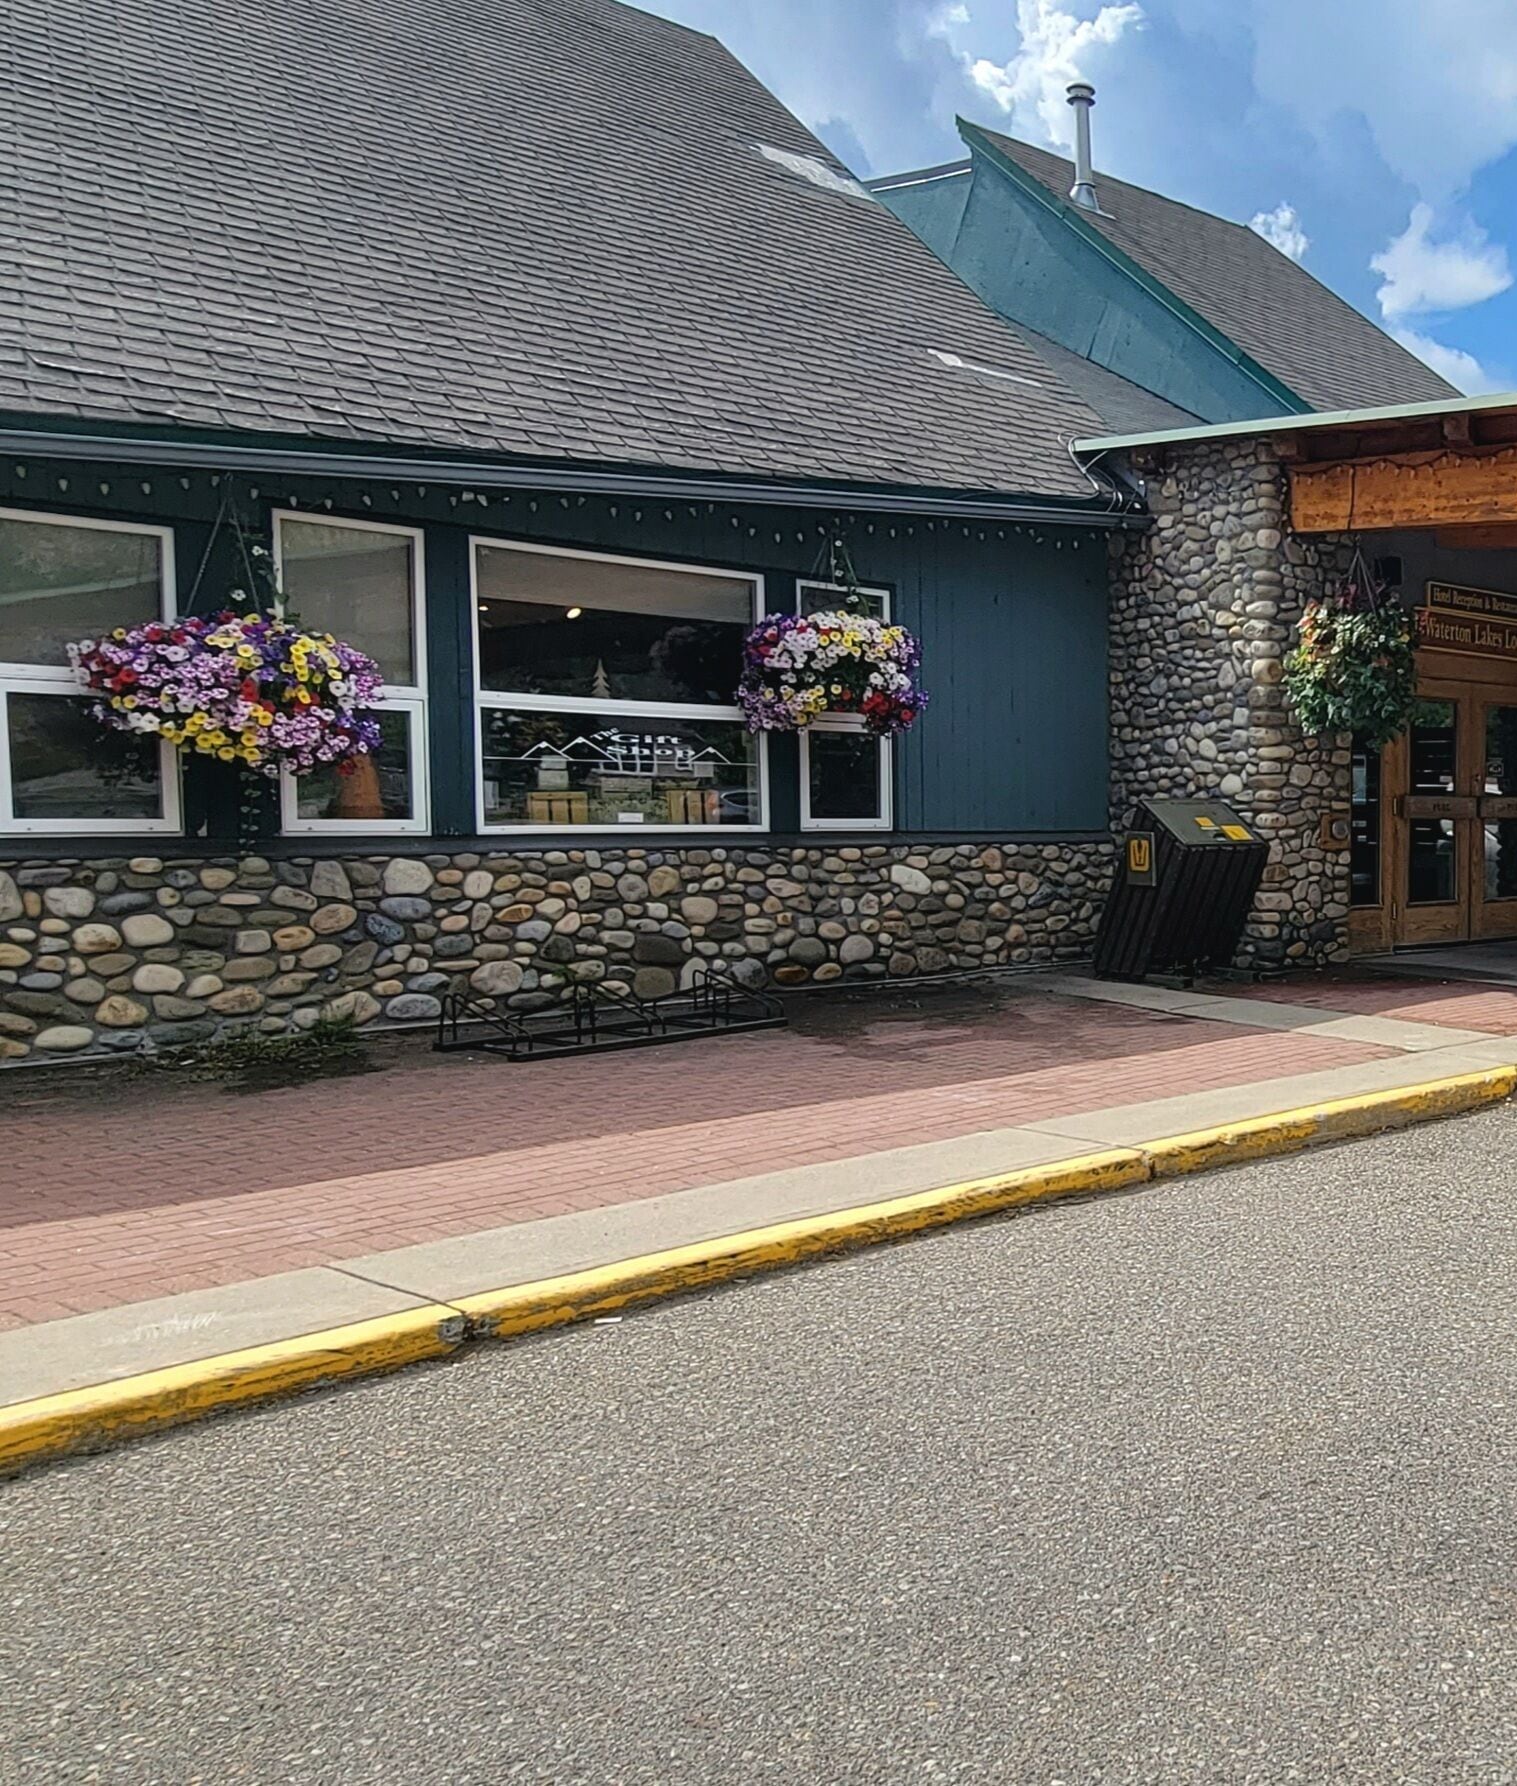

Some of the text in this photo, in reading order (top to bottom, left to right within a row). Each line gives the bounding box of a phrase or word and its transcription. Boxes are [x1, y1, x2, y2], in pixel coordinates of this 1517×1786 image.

[1425, 617, 1471, 643] Waterton
[1474, 624, 1503, 648] Lakes
[589, 727, 620, 740] The
[610, 734, 681, 744] Gift
[606, 746, 695, 758] Shop
